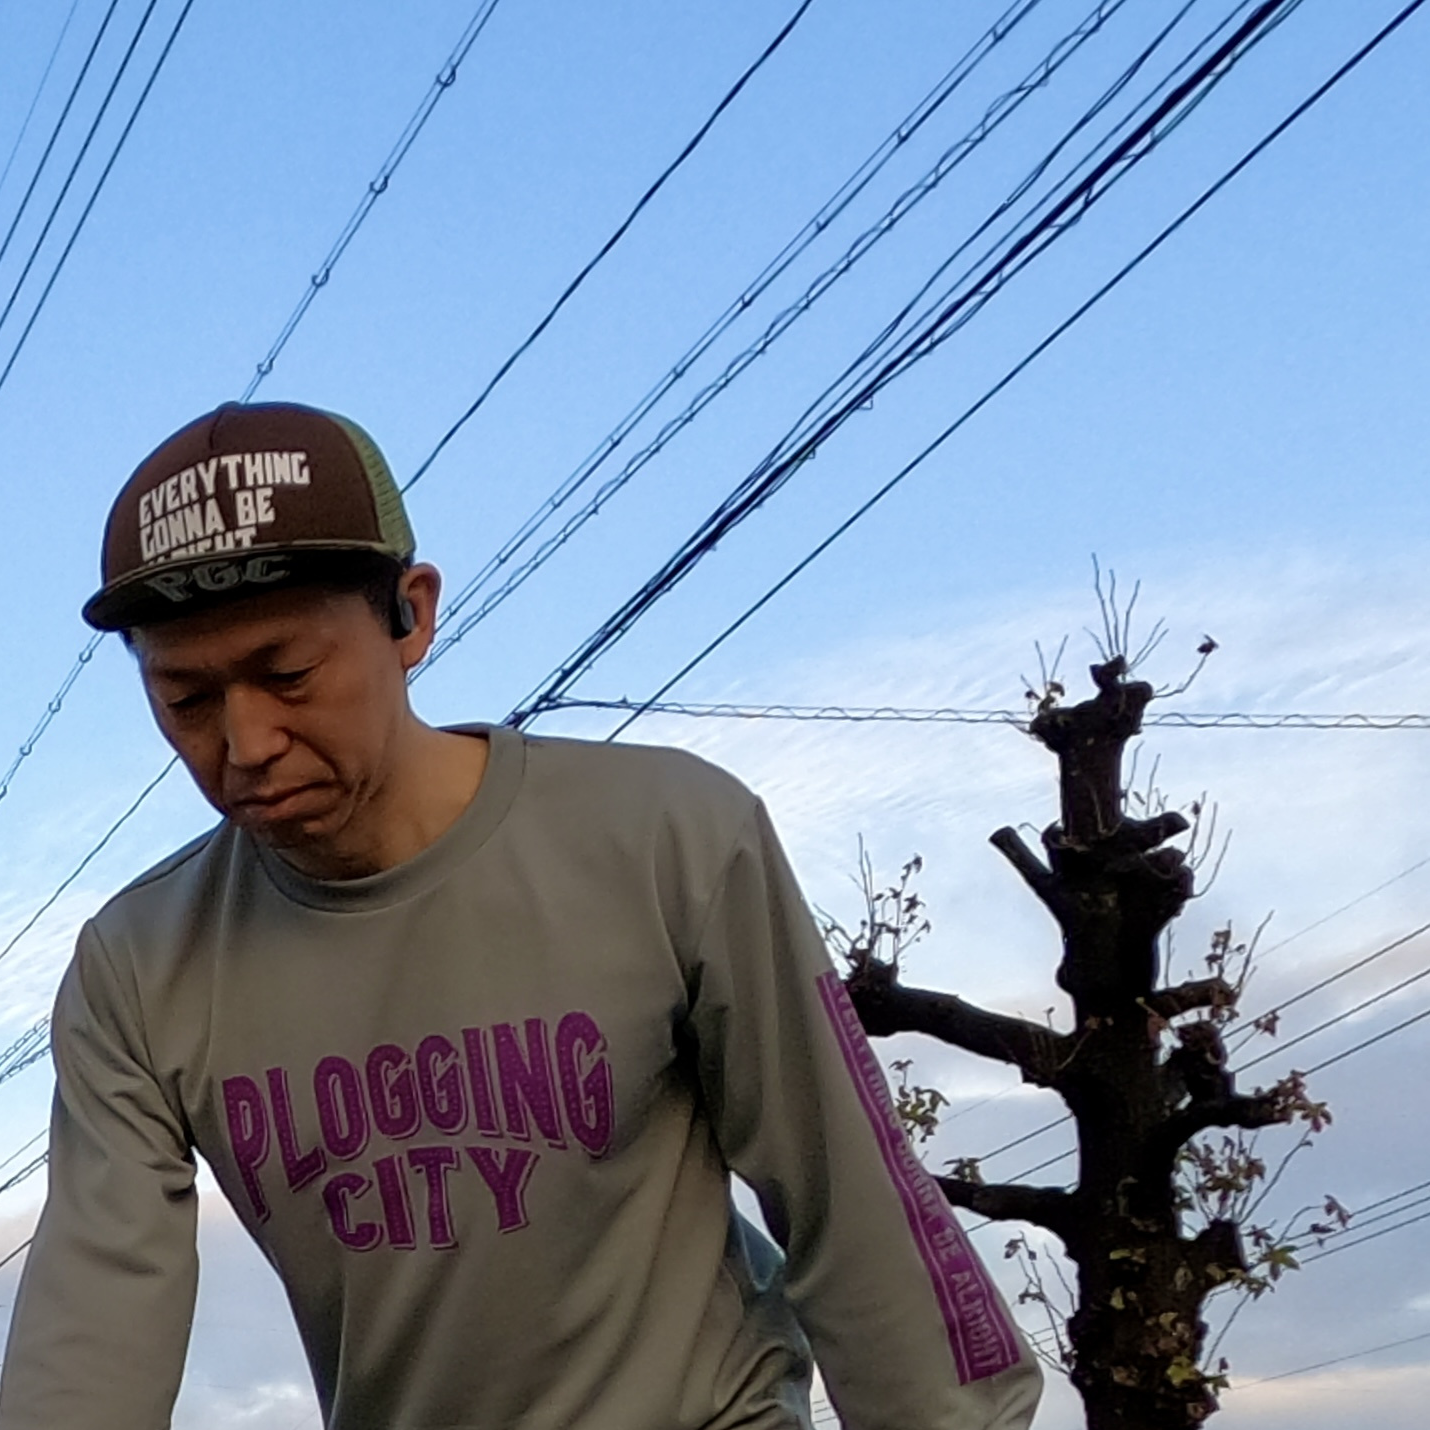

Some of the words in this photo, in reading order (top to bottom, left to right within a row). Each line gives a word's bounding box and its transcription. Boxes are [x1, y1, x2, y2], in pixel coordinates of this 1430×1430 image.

[139, 452, 311, 528] EVERYTHING
[140, 498, 226, 563] GONNA
[235, 487, 276, 527] BE
[144, 554, 291, 602] PGC
[222, 1011, 613, 1224] PLOGGING
[322, 1146, 539, 1251] CITY
[950, 1270, 1004, 1370] ALRIGHT
